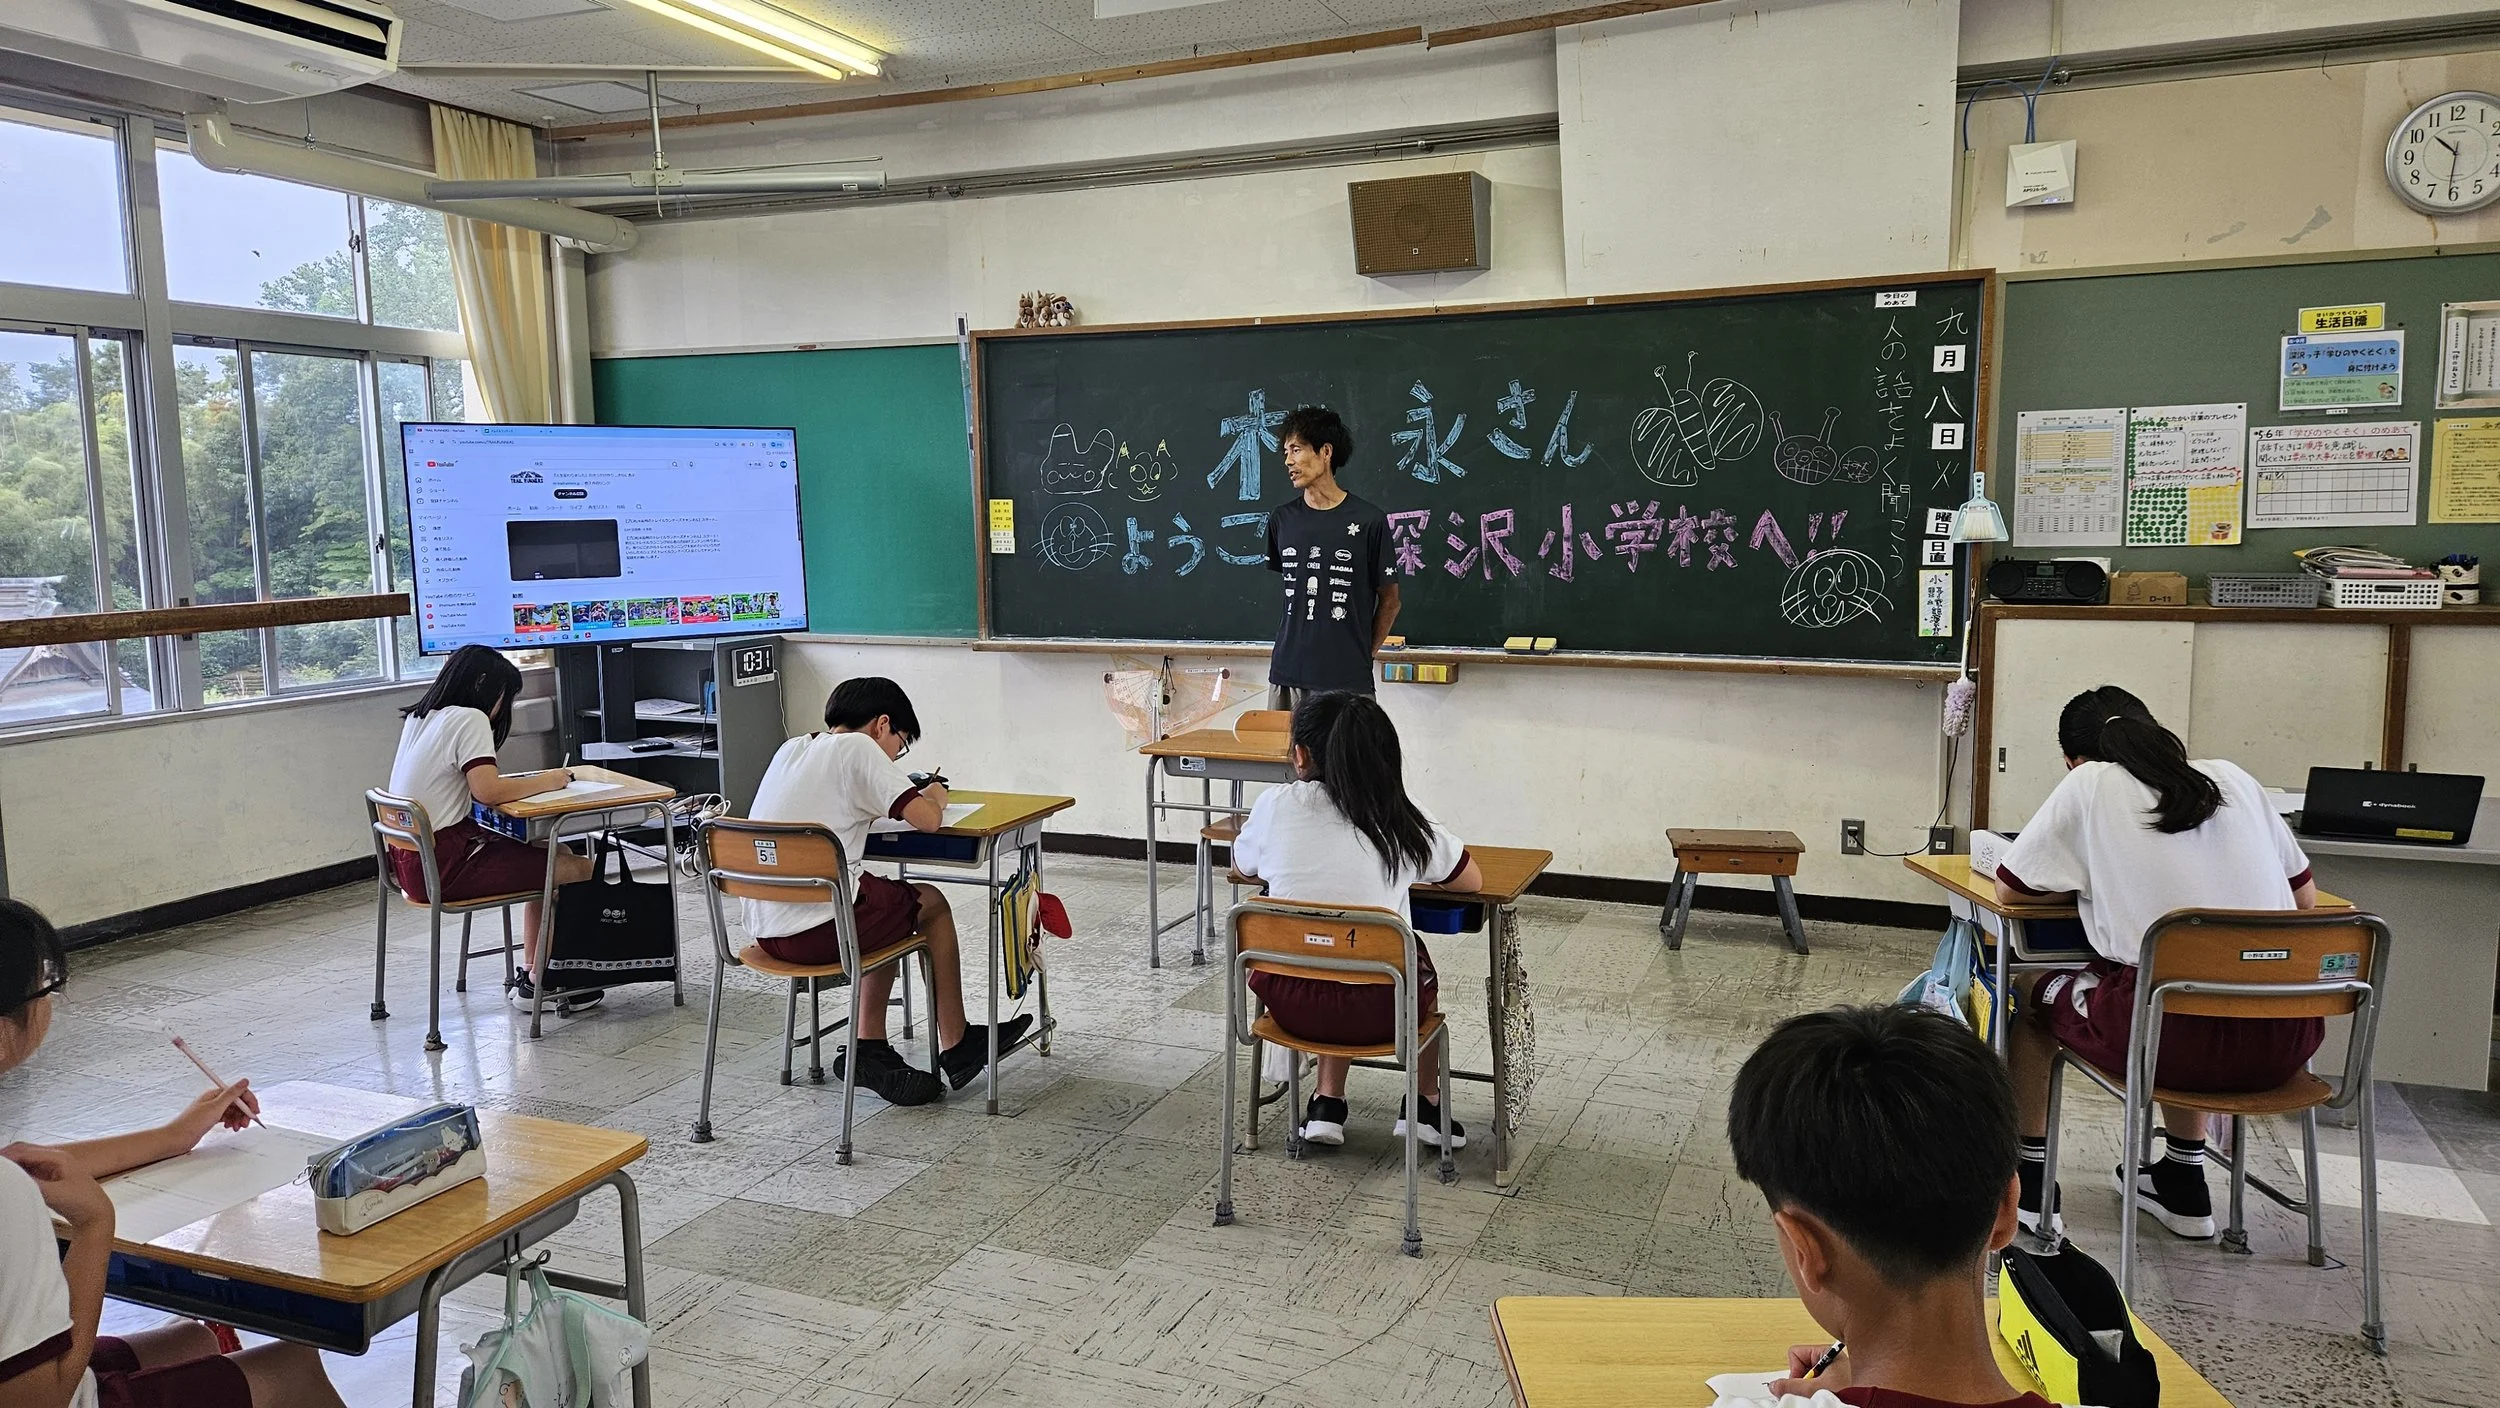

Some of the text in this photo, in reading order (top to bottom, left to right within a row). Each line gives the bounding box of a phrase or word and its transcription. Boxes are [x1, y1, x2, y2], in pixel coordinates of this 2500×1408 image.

[2428, 112, 2441, 128] 11
[2450, 104, 2466, 121] 12
[2479, 108, 2485, 123] 1
[2410, 128, 2425, 144] 10
[2403, 149, 2415, 165] 9
[2409, 169, 2420, 185] 8
[2488, 163, 2500, 178] 4
[2426, 183, 2437, 198] 7
[2447, 186, 2459, 201] 6
[2472, 179, 2483, 194] 5
[2315, 315, 2368, 329] 生活目標
[1940, 350, 1957, 367] 月
[1940, 428, 1956, 446] 日
[1934, 511, 1953, 534] 曜日
[1929, 541, 1947, 563] 日直
[743, 650, 770, 672] 10:31
[759, 849, 768, 862] 5
[2326, 959, 2336, 968] 5
